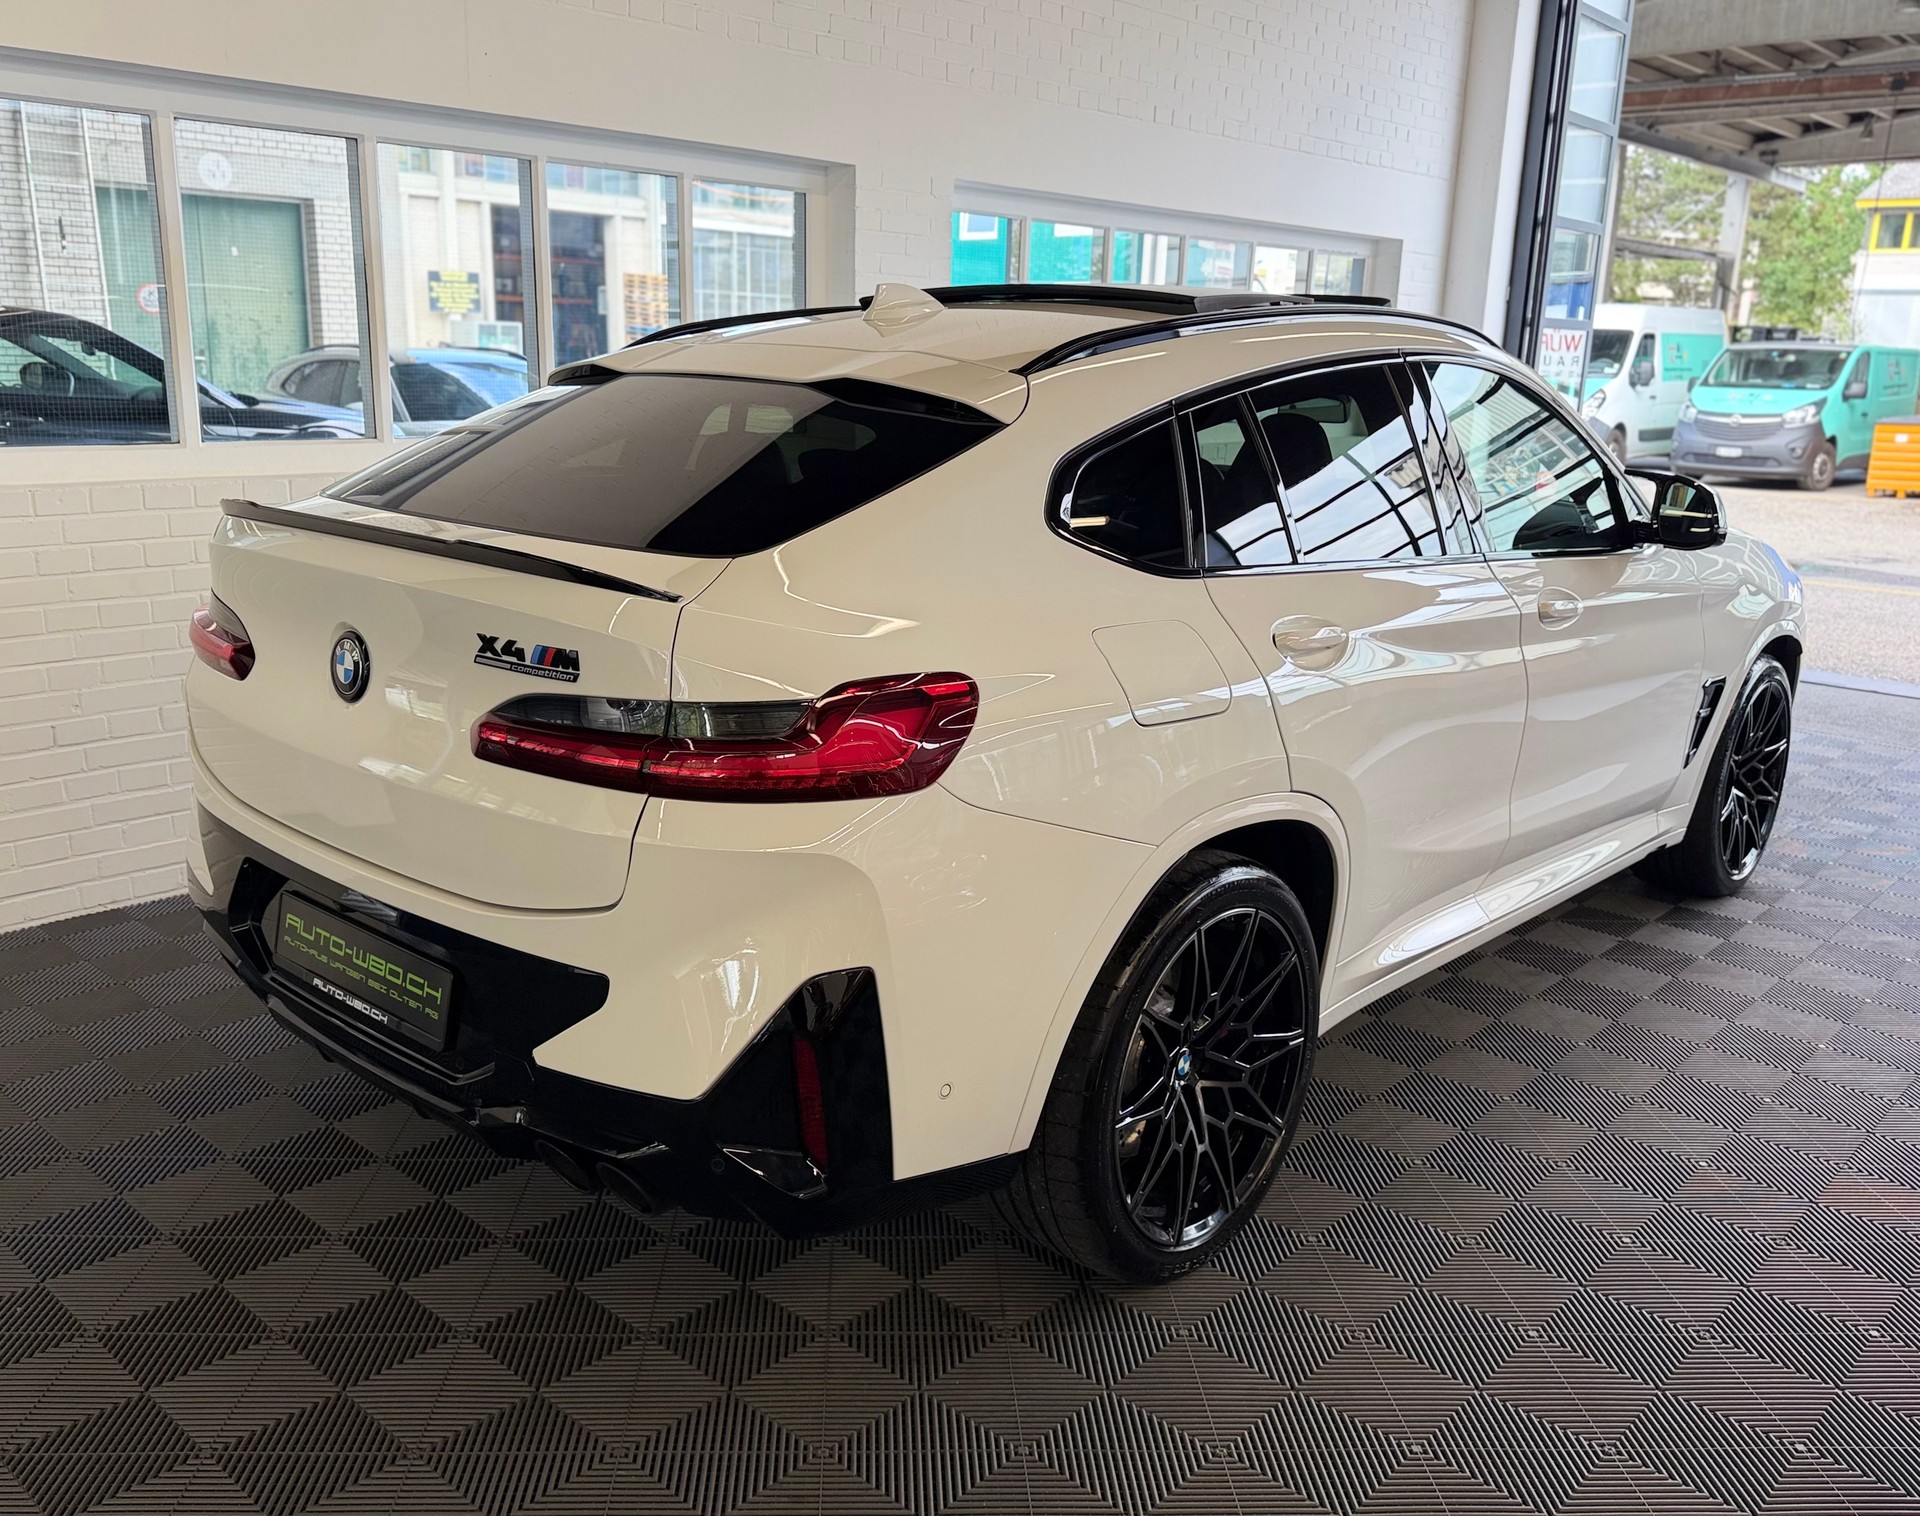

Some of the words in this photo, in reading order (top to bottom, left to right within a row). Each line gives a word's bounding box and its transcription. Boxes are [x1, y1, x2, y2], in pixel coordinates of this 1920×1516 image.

[335, 640, 360, 662] BMW
[476, 633, 526, 662] X4
[511, 664, 574, 681] competition
[285, 913, 442, 1005] AUTO-WBO.CH
[284, 935, 328, 963] AUTOHAUS
[424, 1007, 439, 1020] AG
